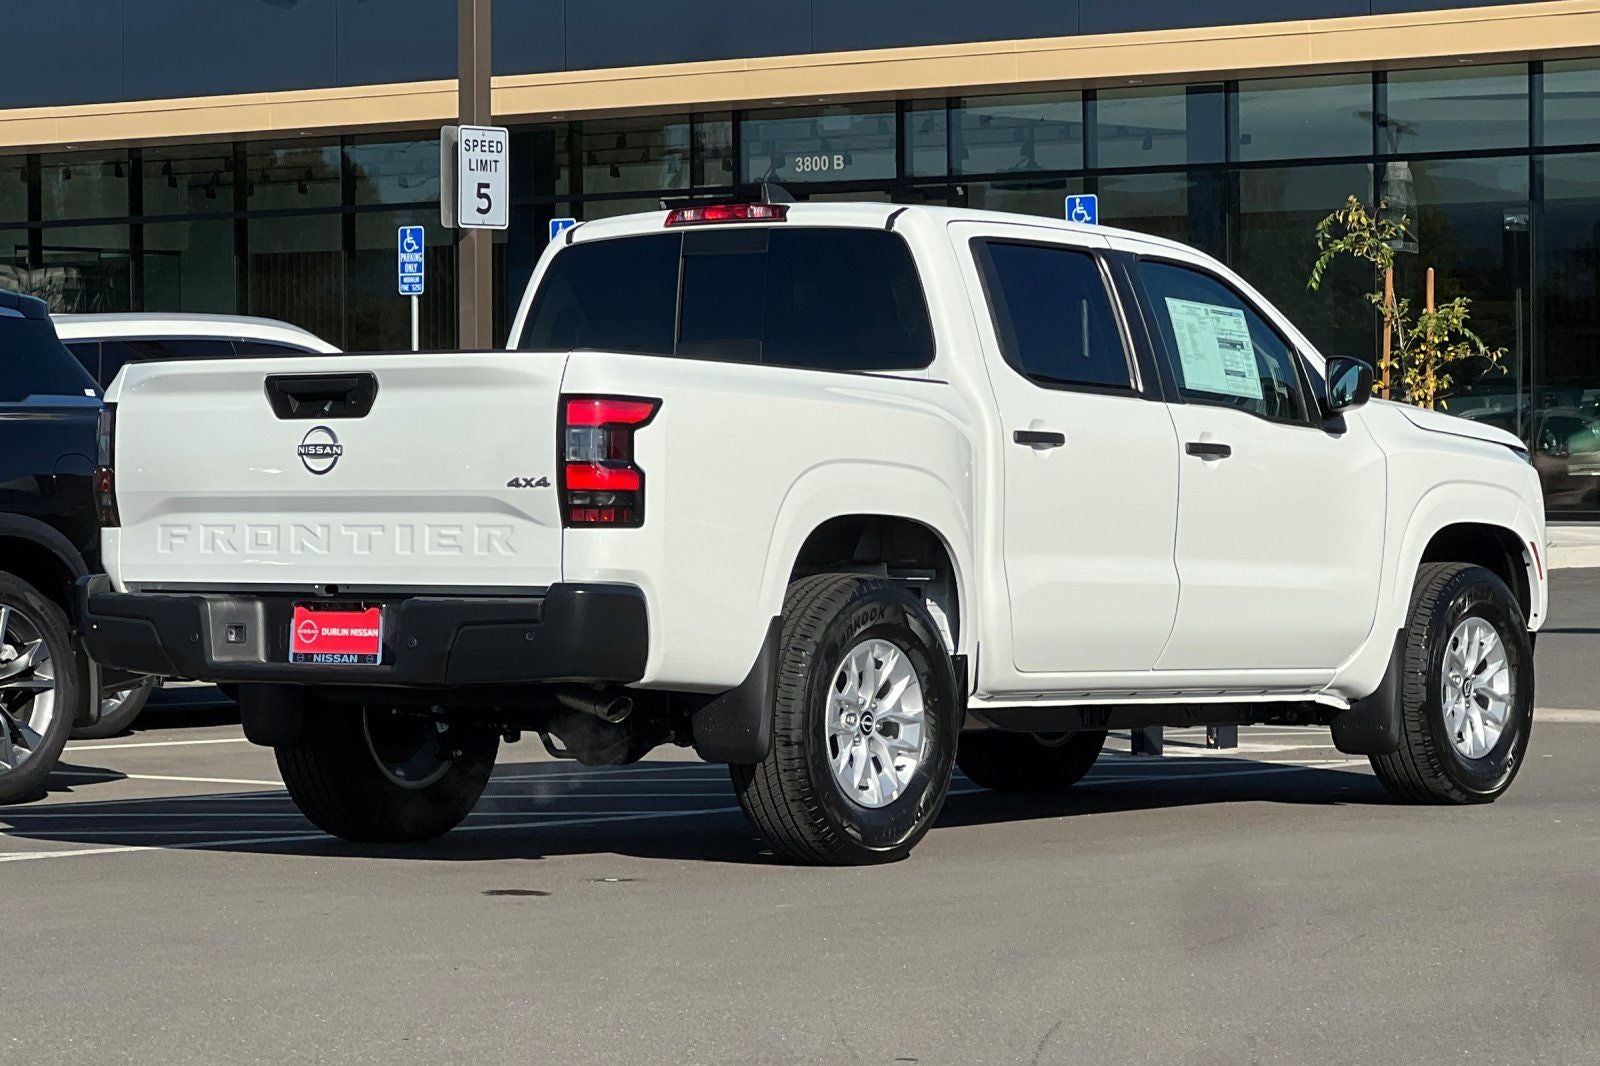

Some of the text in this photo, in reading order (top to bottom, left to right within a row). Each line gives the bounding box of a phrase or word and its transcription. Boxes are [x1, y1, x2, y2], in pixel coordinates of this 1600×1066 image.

[464, 139, 503, 153] SPEED
[468, 159, 499, 172] LIMIT
[796, 155, 844, 171] 3800 B
[476, 183, 492, 214] 5
[400, 252, 422, 262] PARKING
[404, 263, 418, 273] ONLY
[299, 446, 341, 454] NISSAN
[156, 523, 517, 556] FRONTIER
[322, 628, 379, 636] DUBLIN NISSAN
[313, 654, 357, 662] NISSAN
